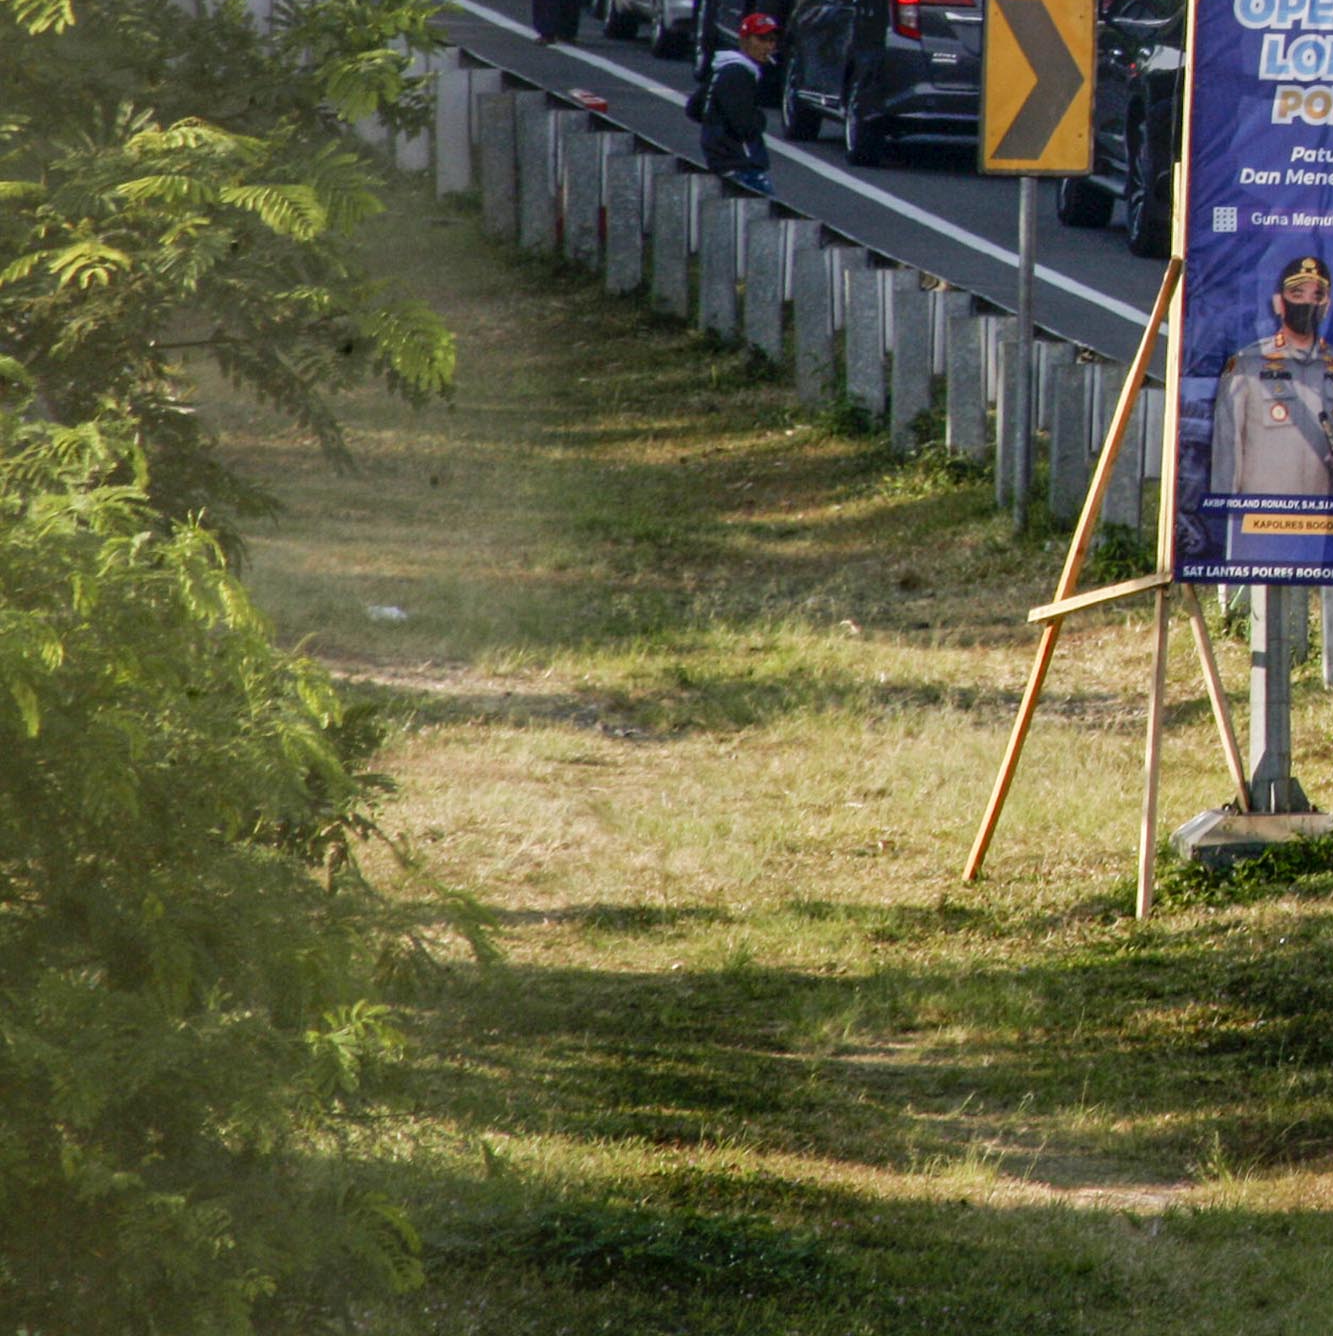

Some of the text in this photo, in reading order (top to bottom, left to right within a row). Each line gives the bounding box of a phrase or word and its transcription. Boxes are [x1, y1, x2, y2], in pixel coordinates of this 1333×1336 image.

[1239, 168, 1281, 186] Dan
[1251, 212, 1288, 227] Guna
[1203, 498, 1226, 508] AKBP
[1226, 499, 1260, 509] ROLAND
[1252, 520, 1304, 530] KAPOLRES
[1182, 566, 1204, 577] SAT
[1206, 567, 1250, 578] LANTAS
[1252, 567, 1293, 579] POLRES
